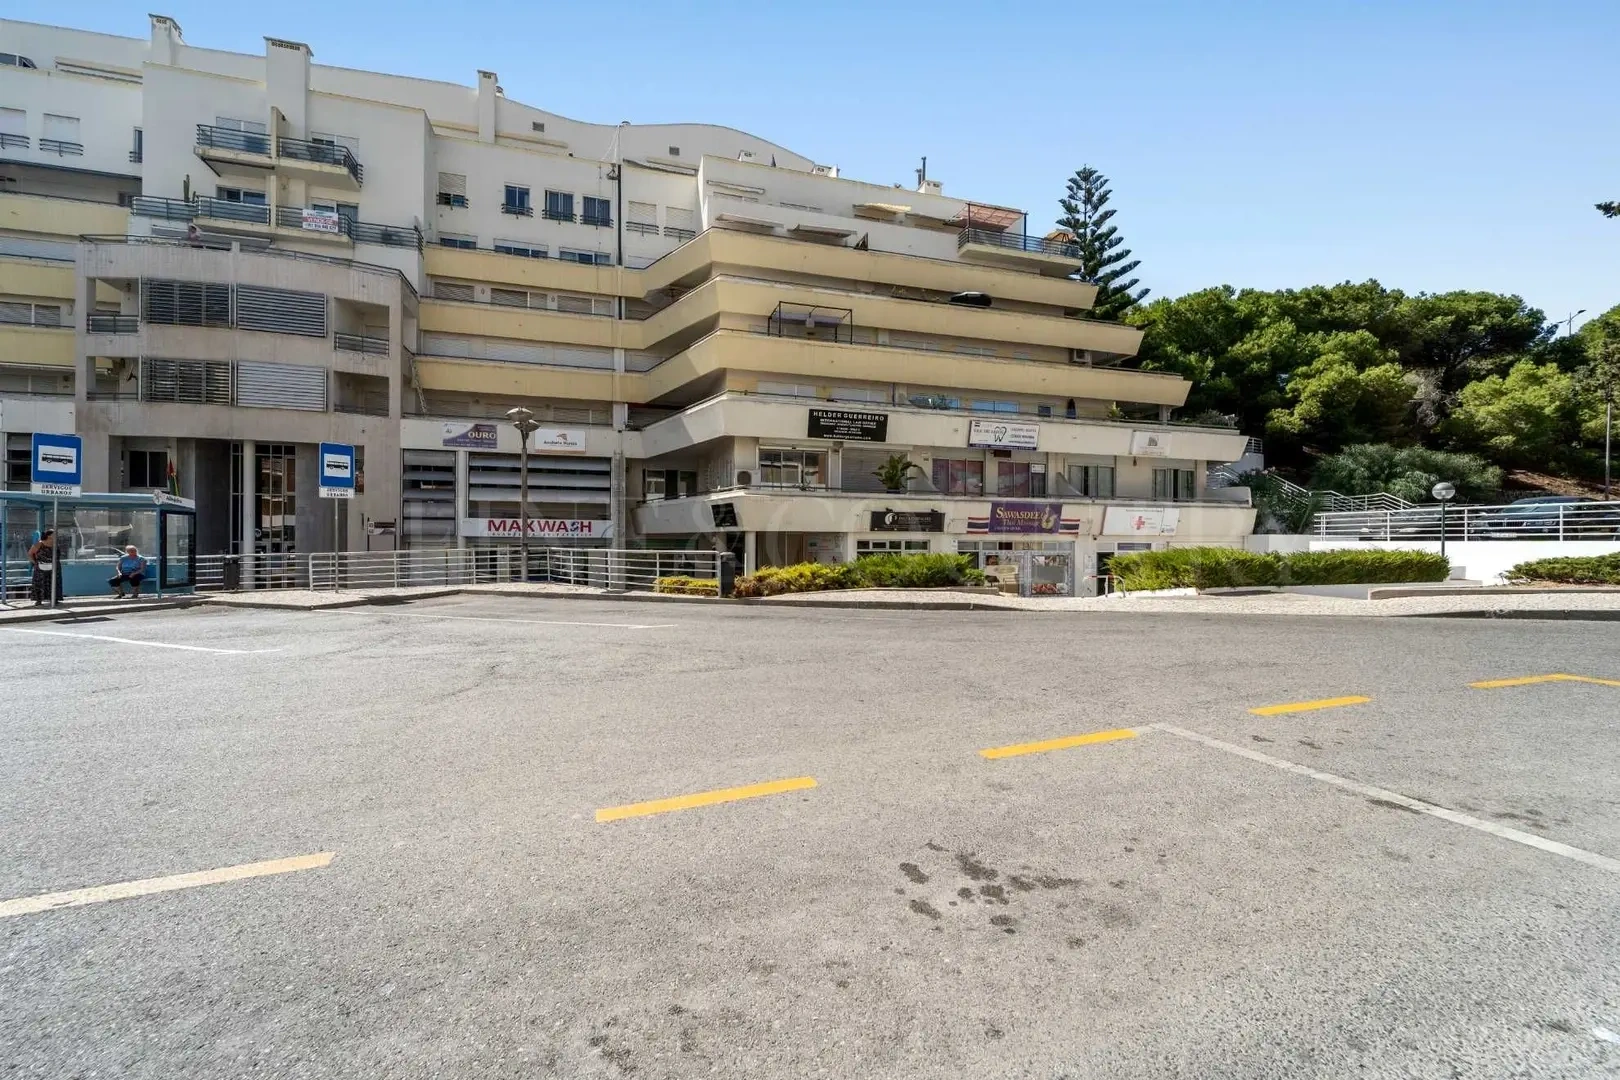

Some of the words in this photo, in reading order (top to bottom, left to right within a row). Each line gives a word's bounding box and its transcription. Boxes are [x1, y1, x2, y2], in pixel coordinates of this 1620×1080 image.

[843, 413, 885, 421] GUERREIRO
[467, 431, 496, 439] OURO
[996, 506, 1042, 519] SAWASDEE
[487, 519, 592, 533] MAXWASH
